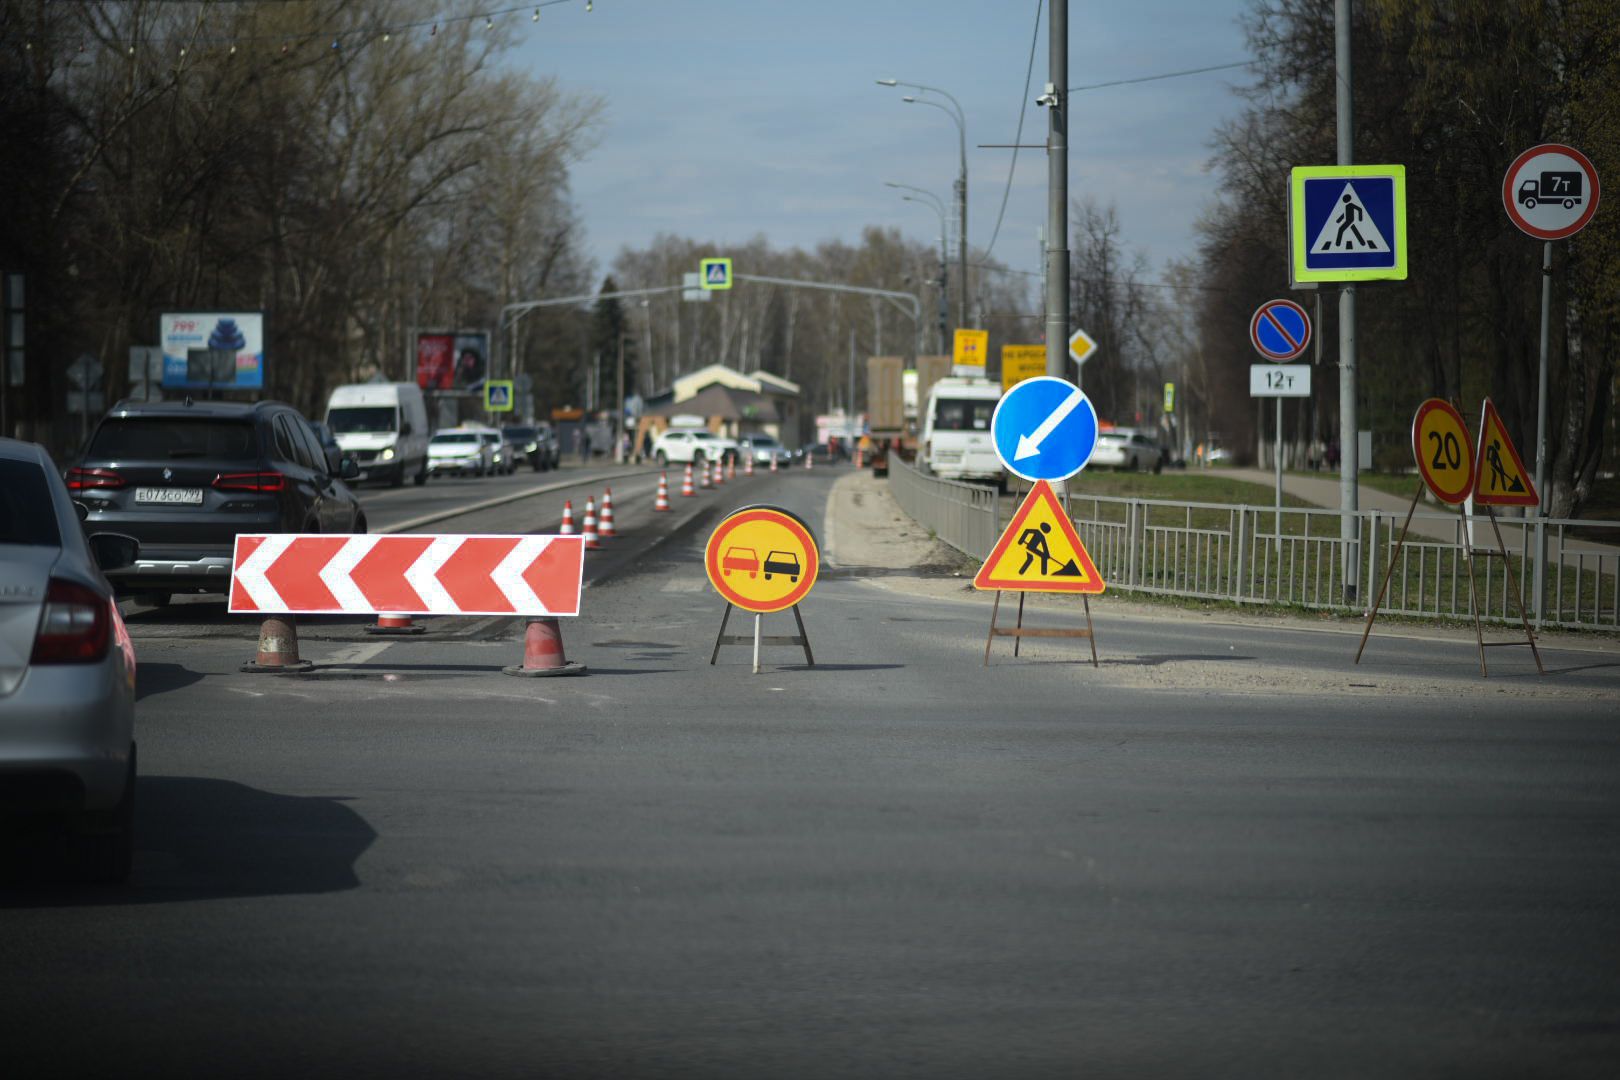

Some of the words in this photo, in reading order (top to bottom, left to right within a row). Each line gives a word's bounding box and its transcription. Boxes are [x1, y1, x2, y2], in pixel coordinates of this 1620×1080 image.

[1551, 176, 1571, 192] 7т
[1265, 370, 1294, 389] 12т
[1428, 431, 1461, 470] 20
